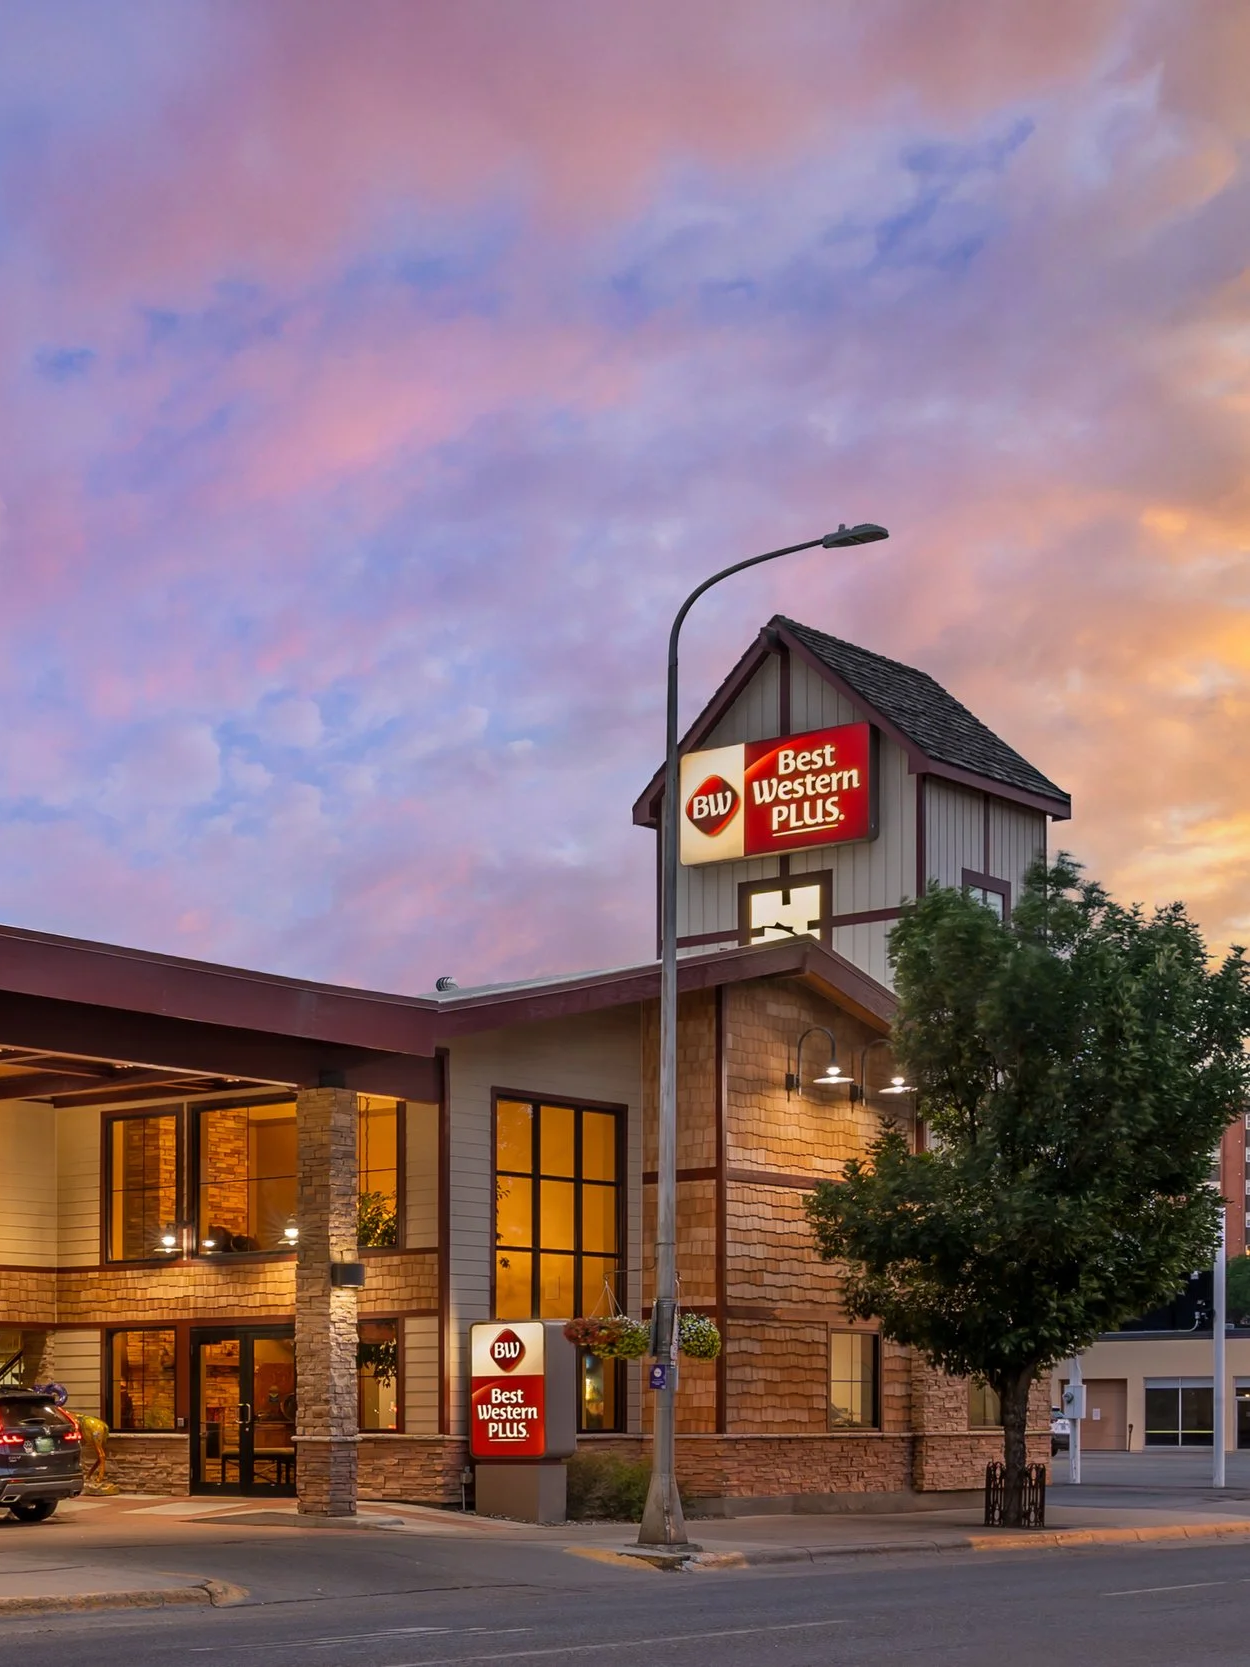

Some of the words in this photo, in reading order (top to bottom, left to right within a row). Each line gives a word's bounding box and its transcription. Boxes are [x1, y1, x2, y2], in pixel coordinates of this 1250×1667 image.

[778, 744, 837, 776] Best
[752, 767, 861, 806] Western
[692, 789, 732, 820] BW
[494, 1341, 520, 1359] BW
[491, 1388, 524, 1404] Best
[477, 1404, 538, 1420] Western
